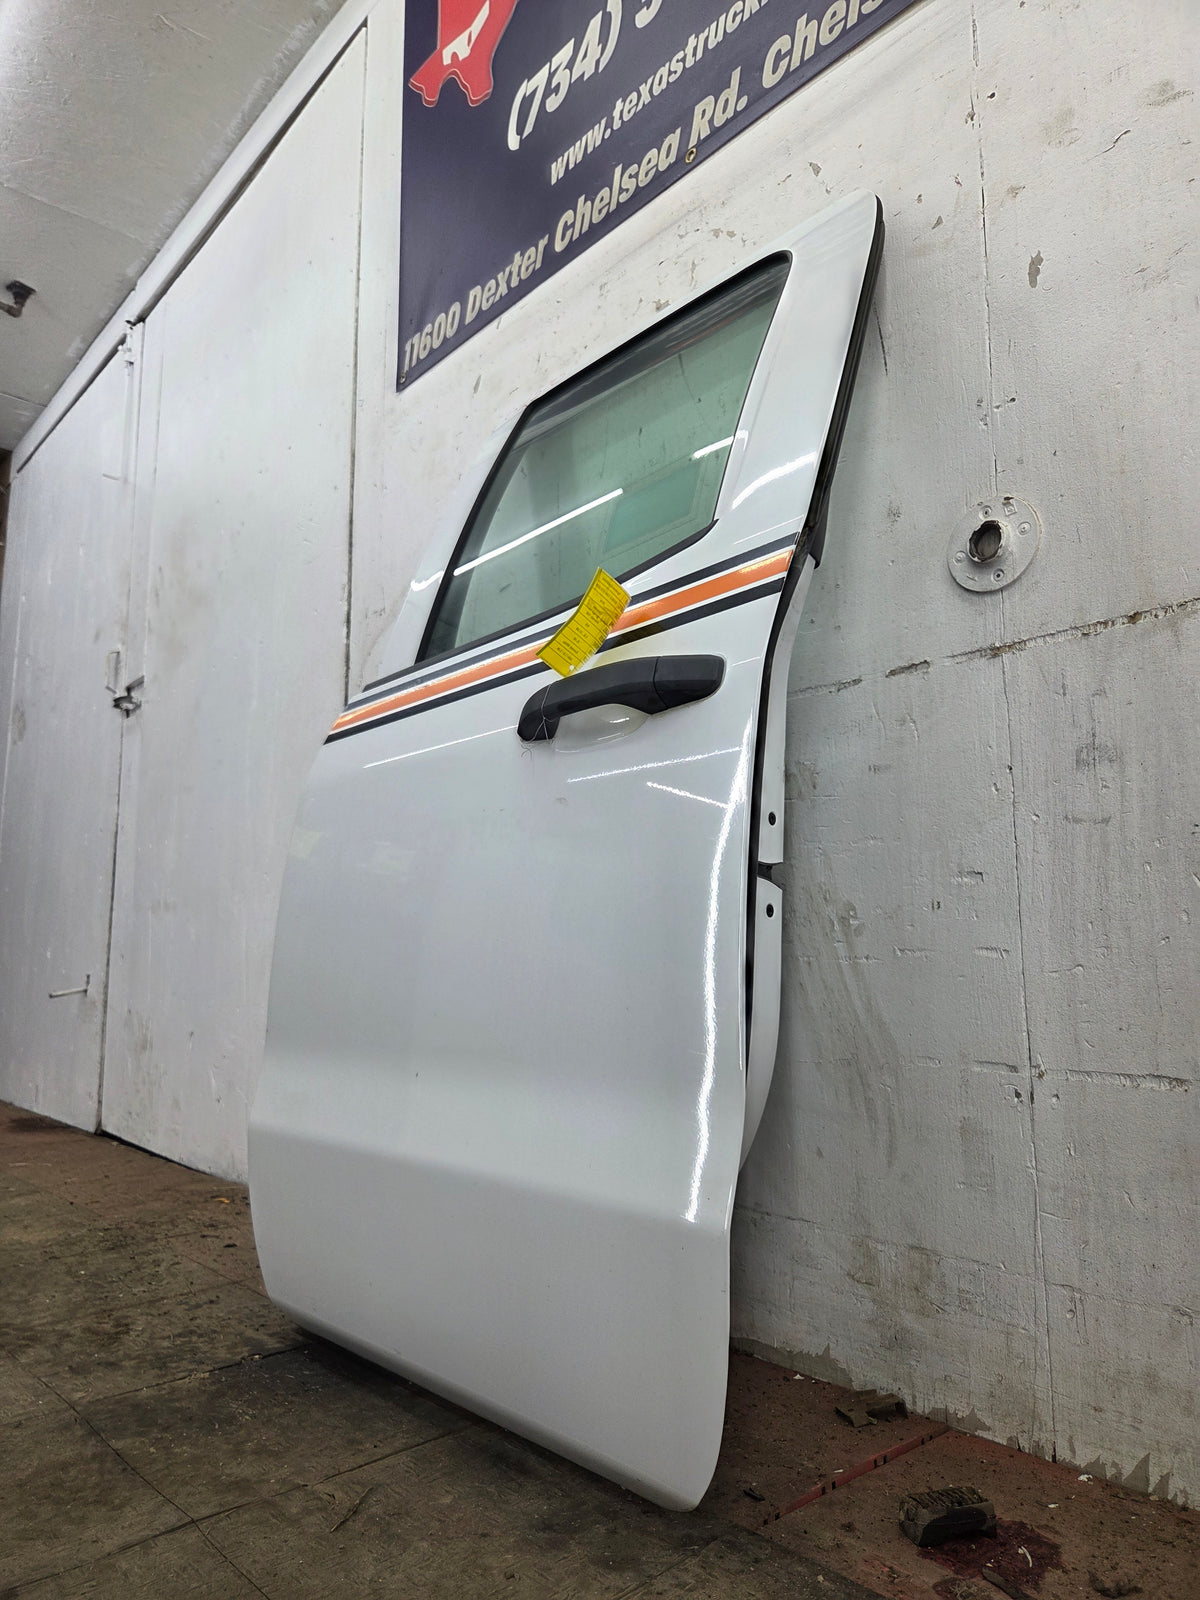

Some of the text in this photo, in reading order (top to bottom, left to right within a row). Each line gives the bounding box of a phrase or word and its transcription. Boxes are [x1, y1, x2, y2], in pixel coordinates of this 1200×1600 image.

[508, 0, 623, 151] (734)
[551, 0, 769, 185] www.texastruck
[404, 301, 462, 372] 11600
[465, 233, 550, 326] Dexter
[554, 126, 682, 252] Chelsea
[688, 66, 748, 149] Rd.
